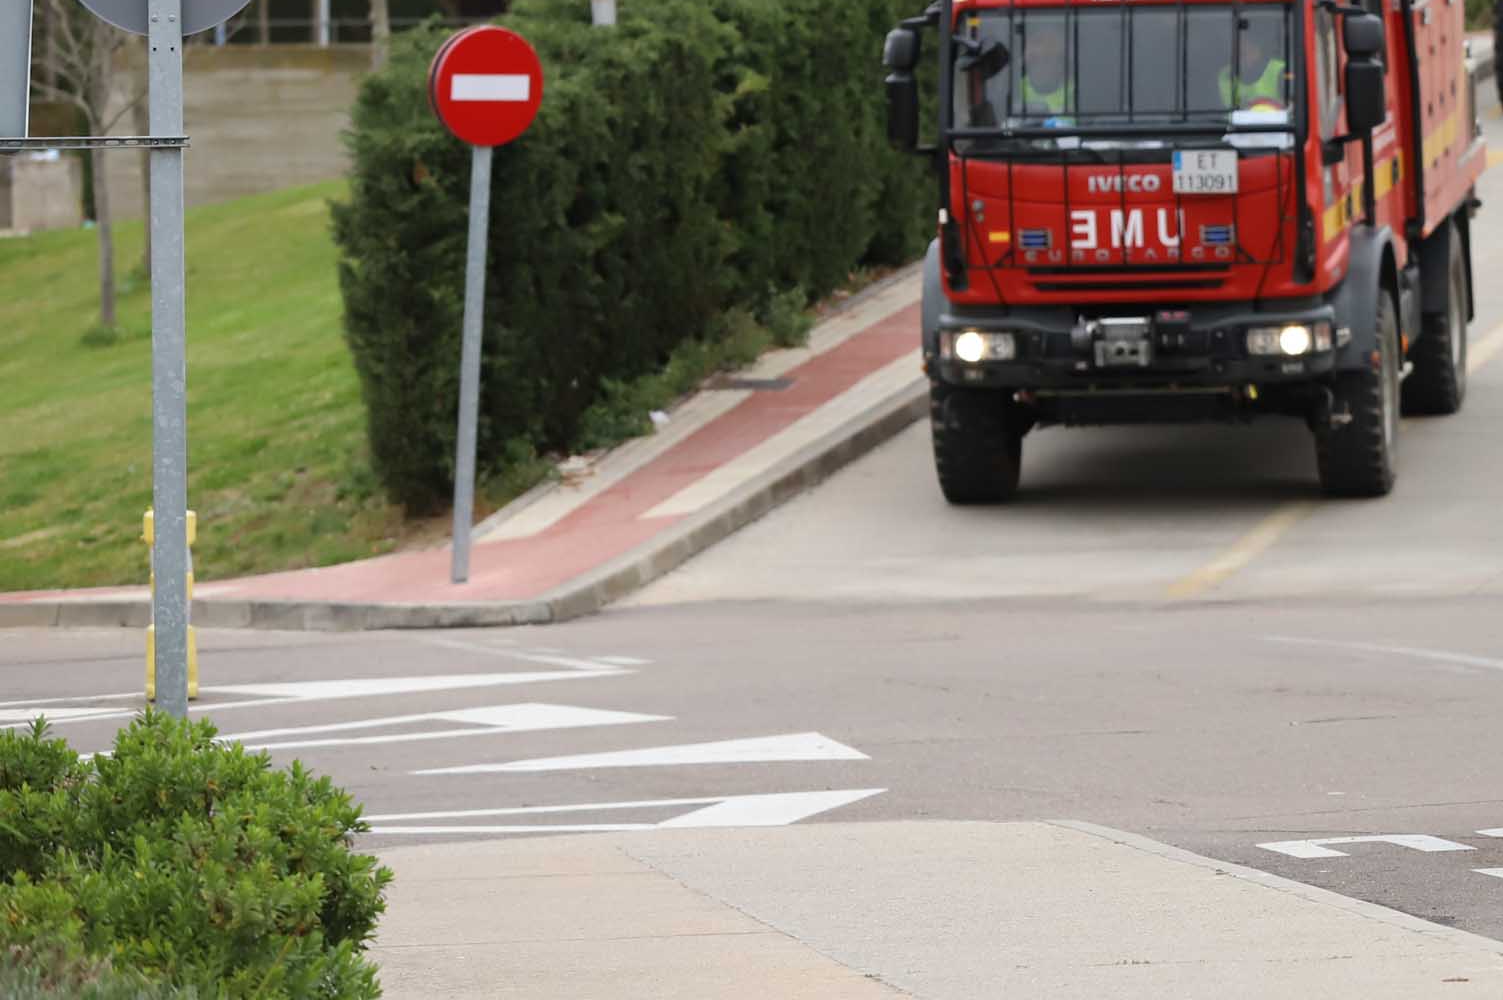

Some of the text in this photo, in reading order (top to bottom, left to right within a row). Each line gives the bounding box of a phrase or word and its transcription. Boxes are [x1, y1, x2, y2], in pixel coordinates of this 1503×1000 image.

[1197, 153, 1216, 169] ET
[1088, 174, 1160, 192] IVECO
[1177, 174, 1233, 190] 113091
